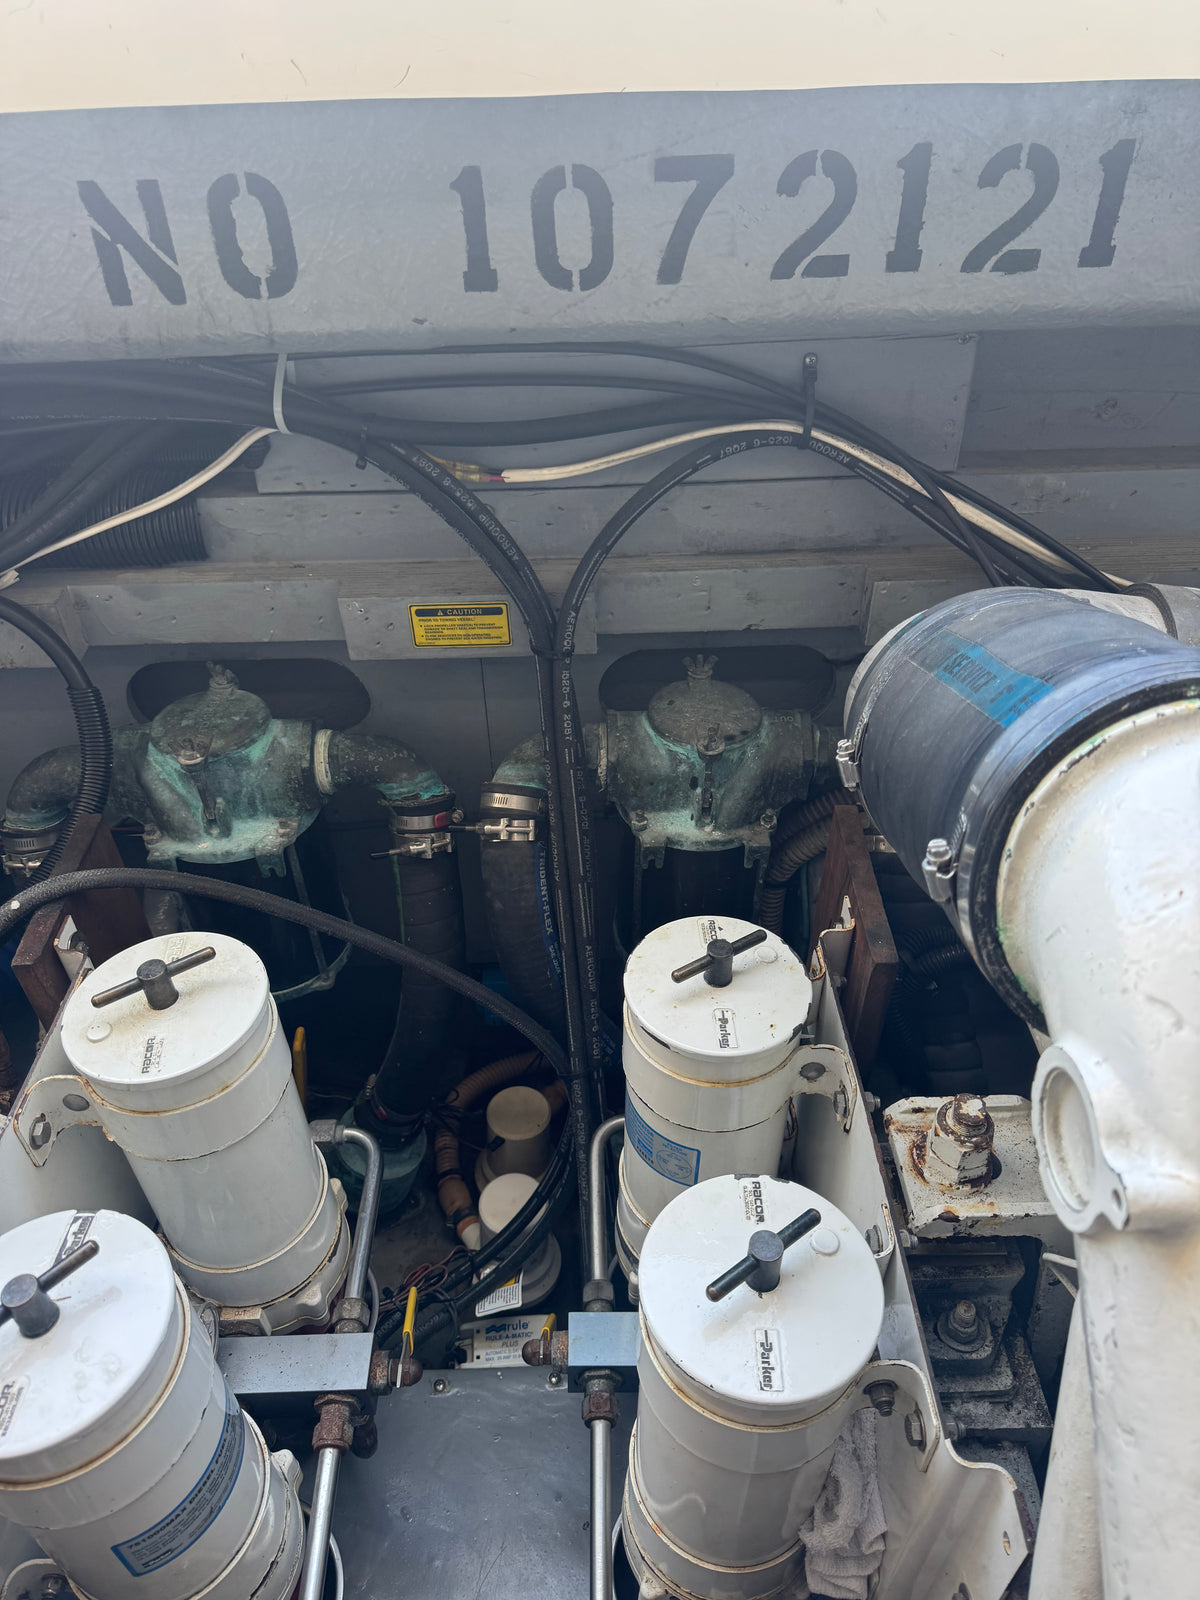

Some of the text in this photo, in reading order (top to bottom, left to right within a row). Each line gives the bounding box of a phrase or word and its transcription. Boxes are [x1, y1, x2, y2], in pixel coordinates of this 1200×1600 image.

[77, 139, 1136, 306] NO 1072121
[479, 513, 520, 561] AEROQUIP
[446, 608, 483, 616] CAUTION
[563, 610, 577, 665] AEROQUP
[538, 850, 554, 936] TRIDENT-FLEX
[584, 944, 597, 993] AEROQUIP
[716, 1011, 731, 1049] Parker
[751, 1181, 766, 1224] RACOR
[506, 1319, 529, 1331] rule
[758, 1333, 774, 1392] Parker
[188, 1467, 216, 1504] DIESEL
